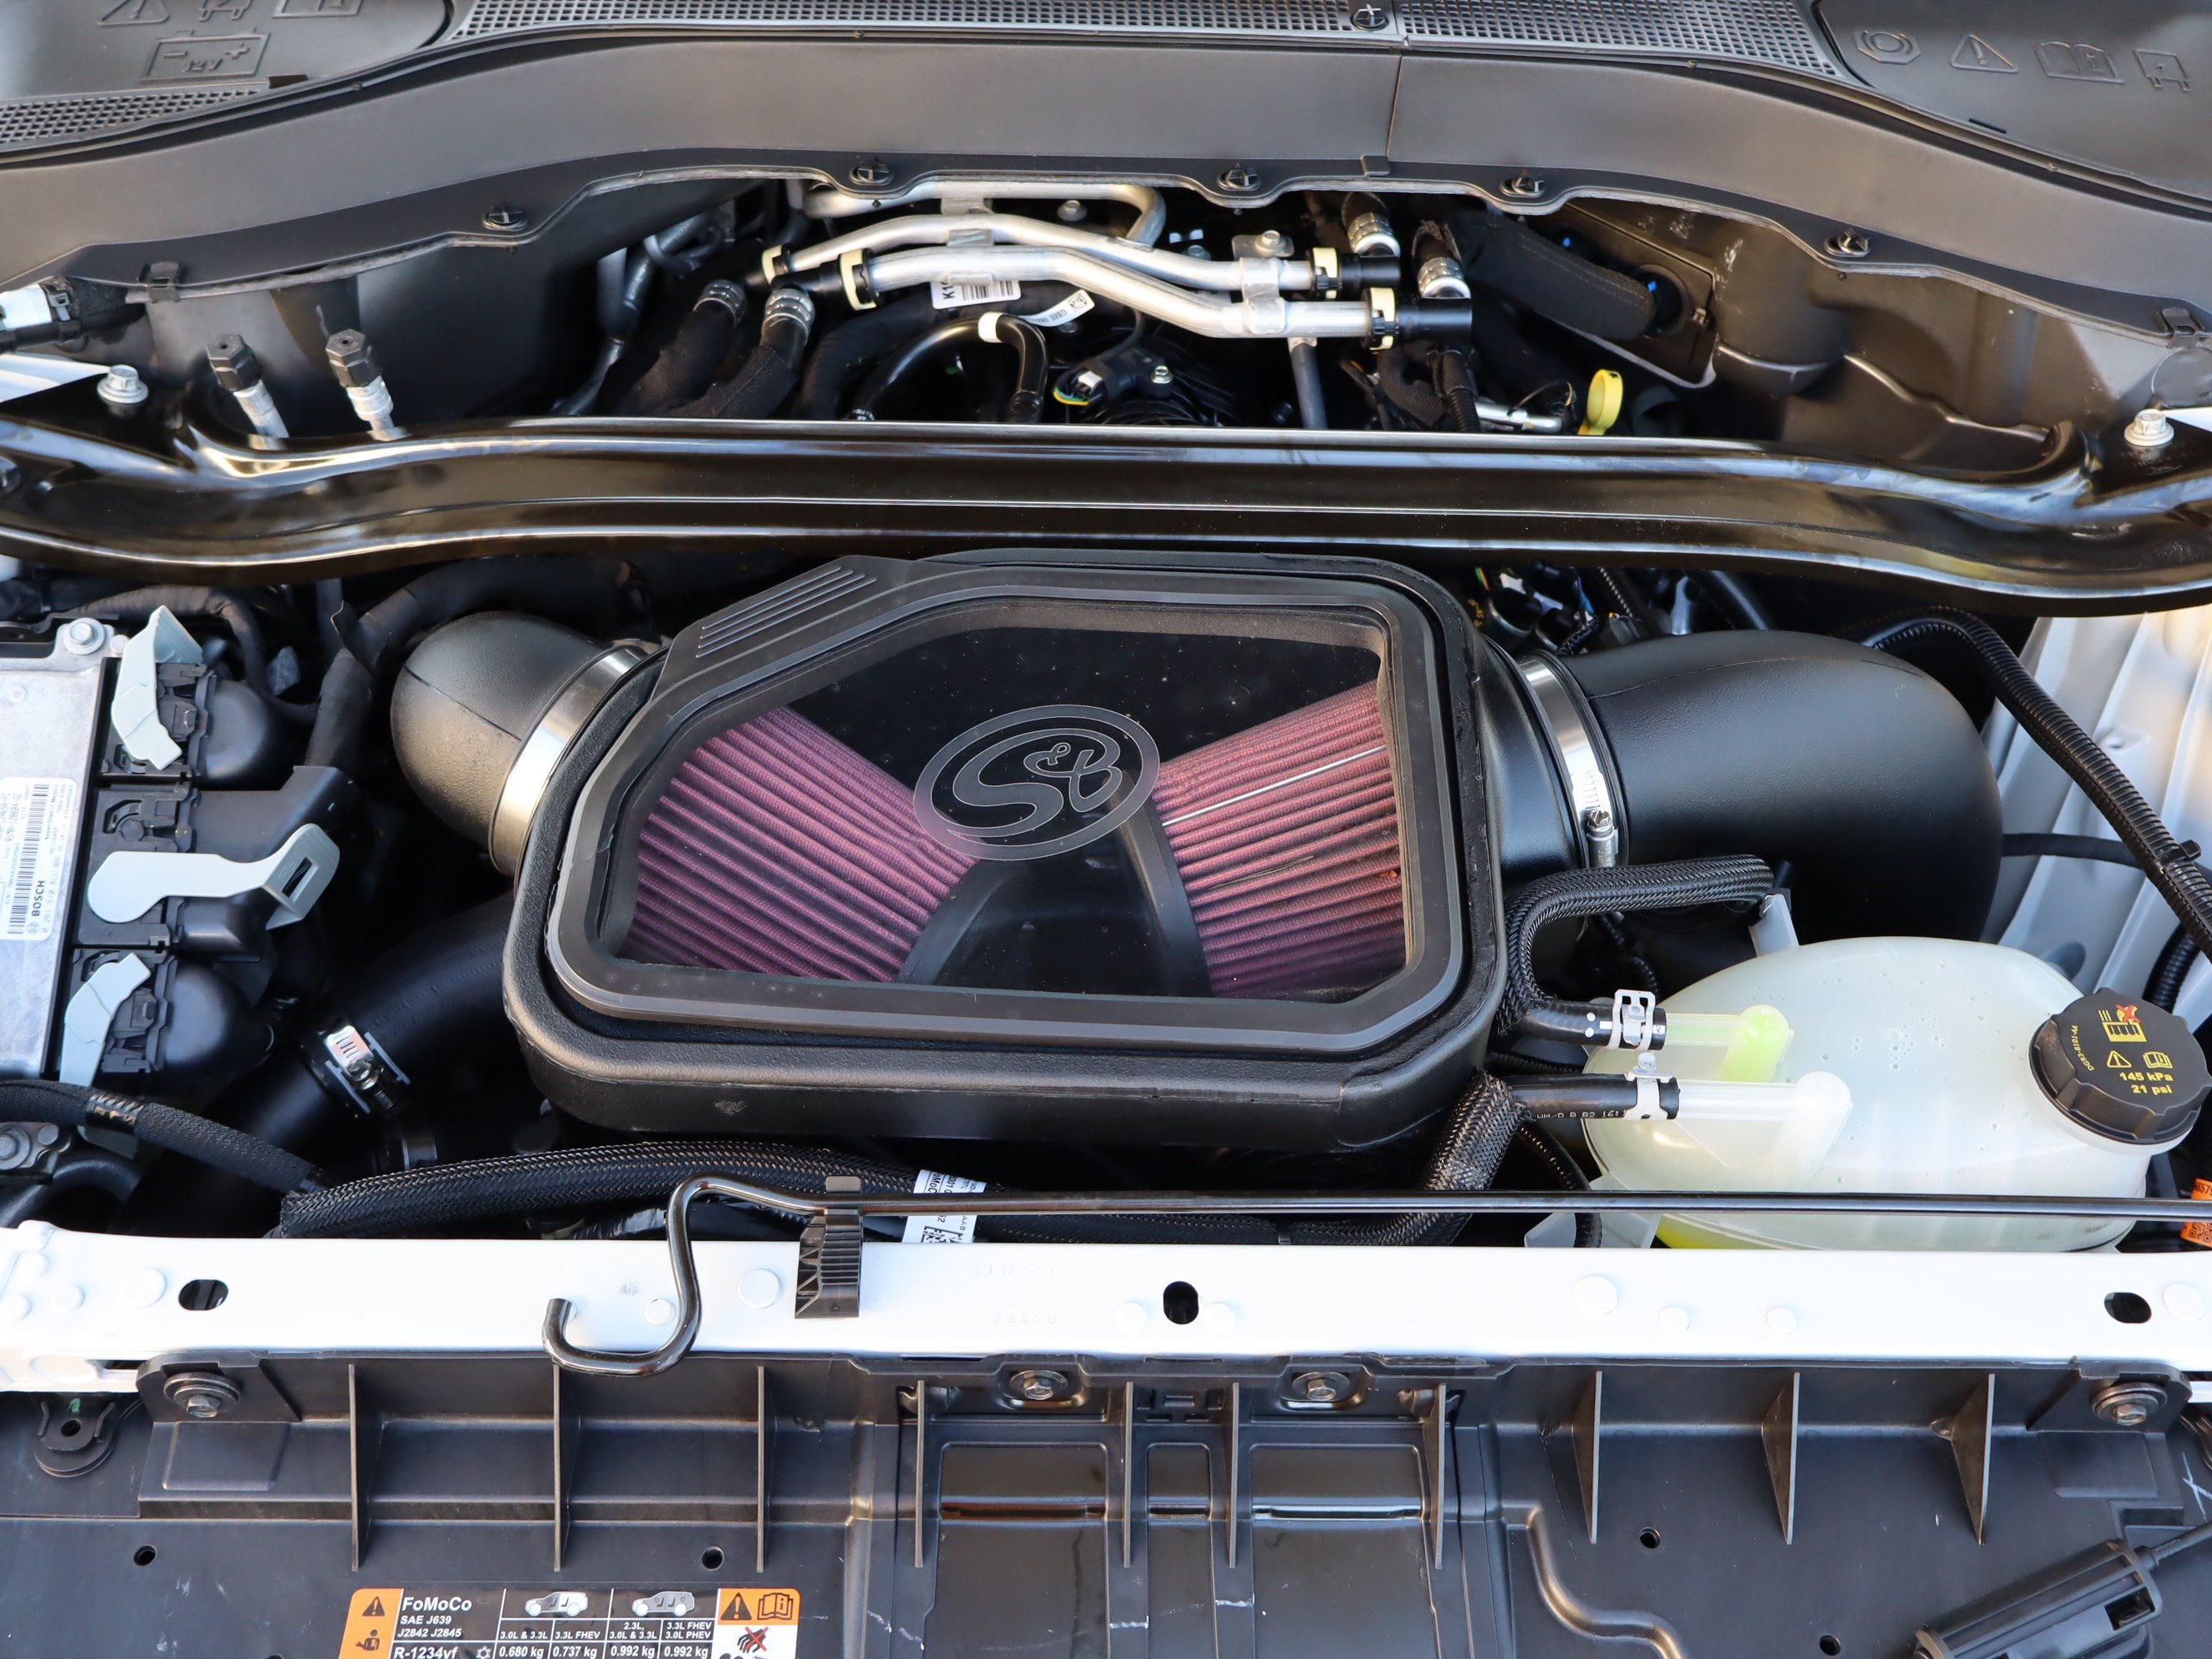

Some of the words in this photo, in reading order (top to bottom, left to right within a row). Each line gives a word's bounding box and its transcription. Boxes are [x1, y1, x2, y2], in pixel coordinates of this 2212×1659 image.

[32, 880, 46, 917] BOSCH
[2120, 1072, 2145, 1081] 145
[2146, 1072, 2174, 1081] kPa
[2131, 1084, 2148, 1094] 21
[2151, 1084, 2173, 1095] psi
[401, 1597, 472, 1612] FoMoCo
[400, 1616, 423, 1625] SAE
[426, 1616, 452, 1625] J639
[624, 1622, 645, 1632] 2.3L,
[397, 1628, 428, 1637] J2842
[431, 1628, 461, 1637] J2845
[501, 1631, 519, 1640] 3.0L
[521, 1631, 528, 1640] &
[531, 1631, 549, 1640] 3.3L
[555, 1631, 574, 1640] 3.3L
[575, 1631, 600, 1640] FHEV
[609, 1631, 627, 1640] 3.0L
[630, 1631, 637, 1640] &
[640, 1631, 657, 1640] 3.3L
[665, 1631, 684, 1639] 3.0L
[685, 1631, 711, 1639] PHEV
[394, 1646, 458, 1659] R-1234yf
[499, 1647, 528, 1657] 0.680
[531, 1646, 544, 1659] kg
[552, 1647, 581, 1657] 0.737
[584, 1646, 598, 1659] kg
[610, 1646, 640, 1657] 0.992
[641, 1646, 655, 1659] kg
[665, 1646, 693, 1657] 0.992
[695, 1646, 709, 1659] kg
